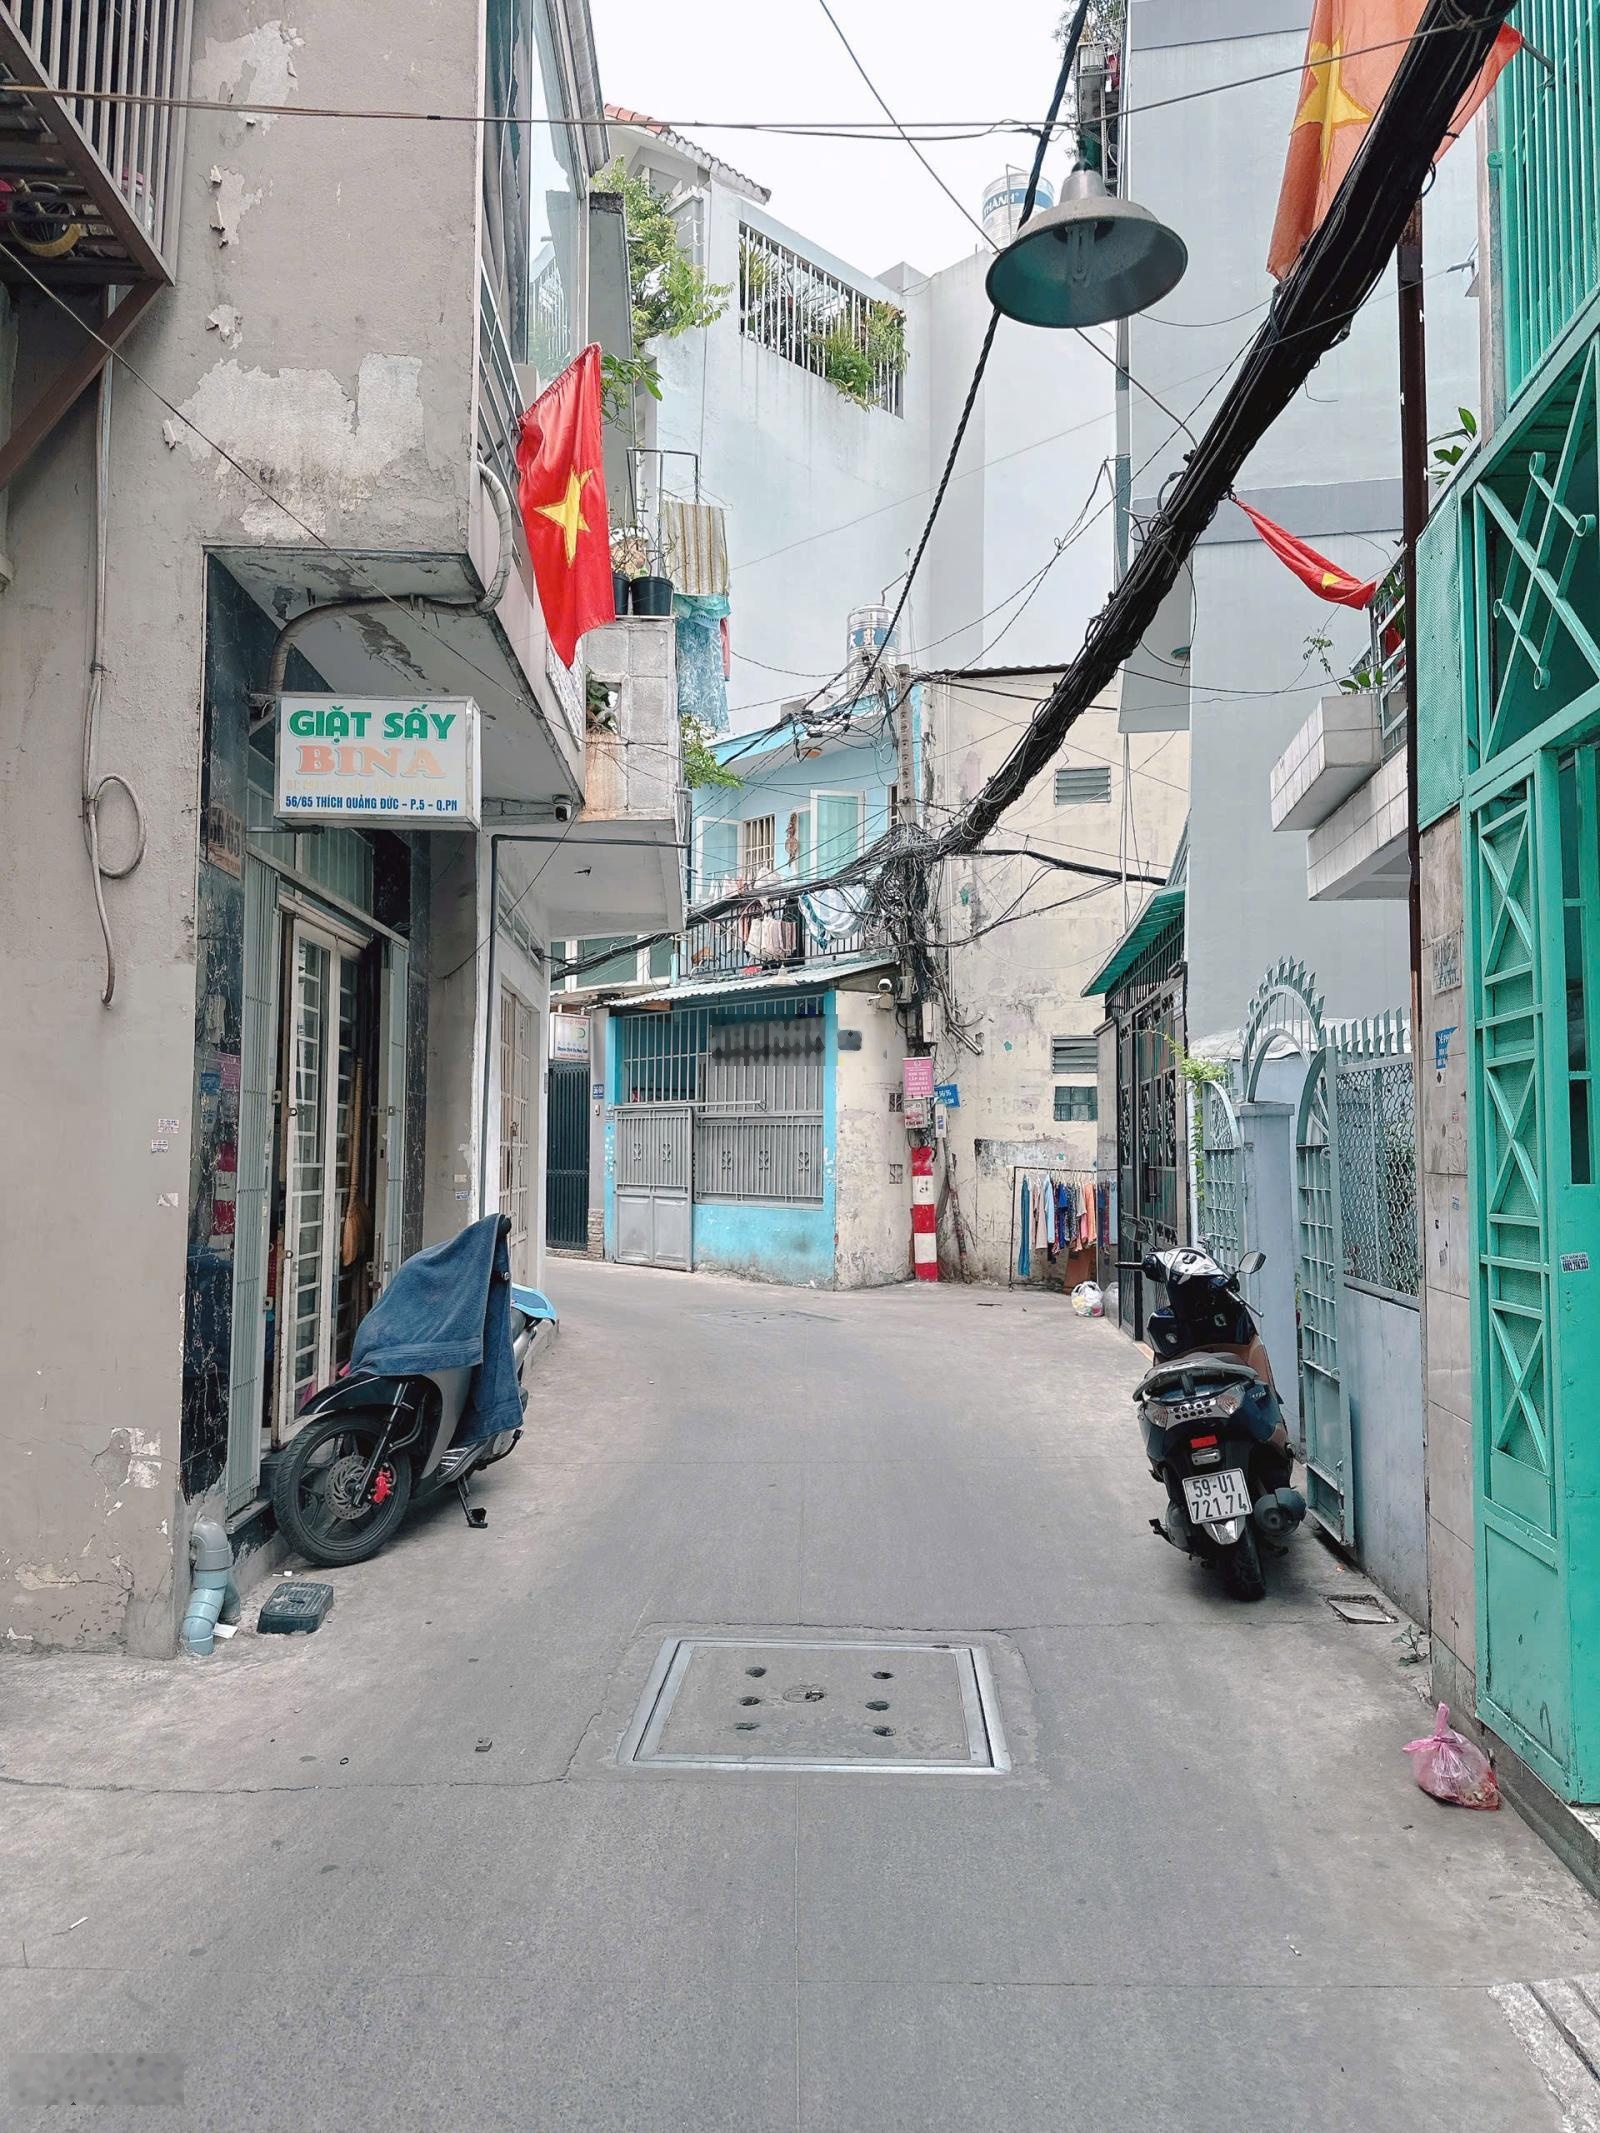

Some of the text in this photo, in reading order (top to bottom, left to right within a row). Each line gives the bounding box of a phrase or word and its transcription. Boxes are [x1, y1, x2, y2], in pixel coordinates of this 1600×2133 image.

[289, 704, 457, 743] GIẶT SẤY
[295, 744, 447, 778] BINA
[285, 795, 313, 808] 56/65
[316, 794, 343, 808] THÍCH
[346, 794, 377, 809] QUẢNG
[380, 795, 399, 810] ĐỨC
[410, 798, 425, 811] P.5
[1192, 1474, 1236, 1498] 59-U1
[1191, 1493, 1248, 1520] 721.74
